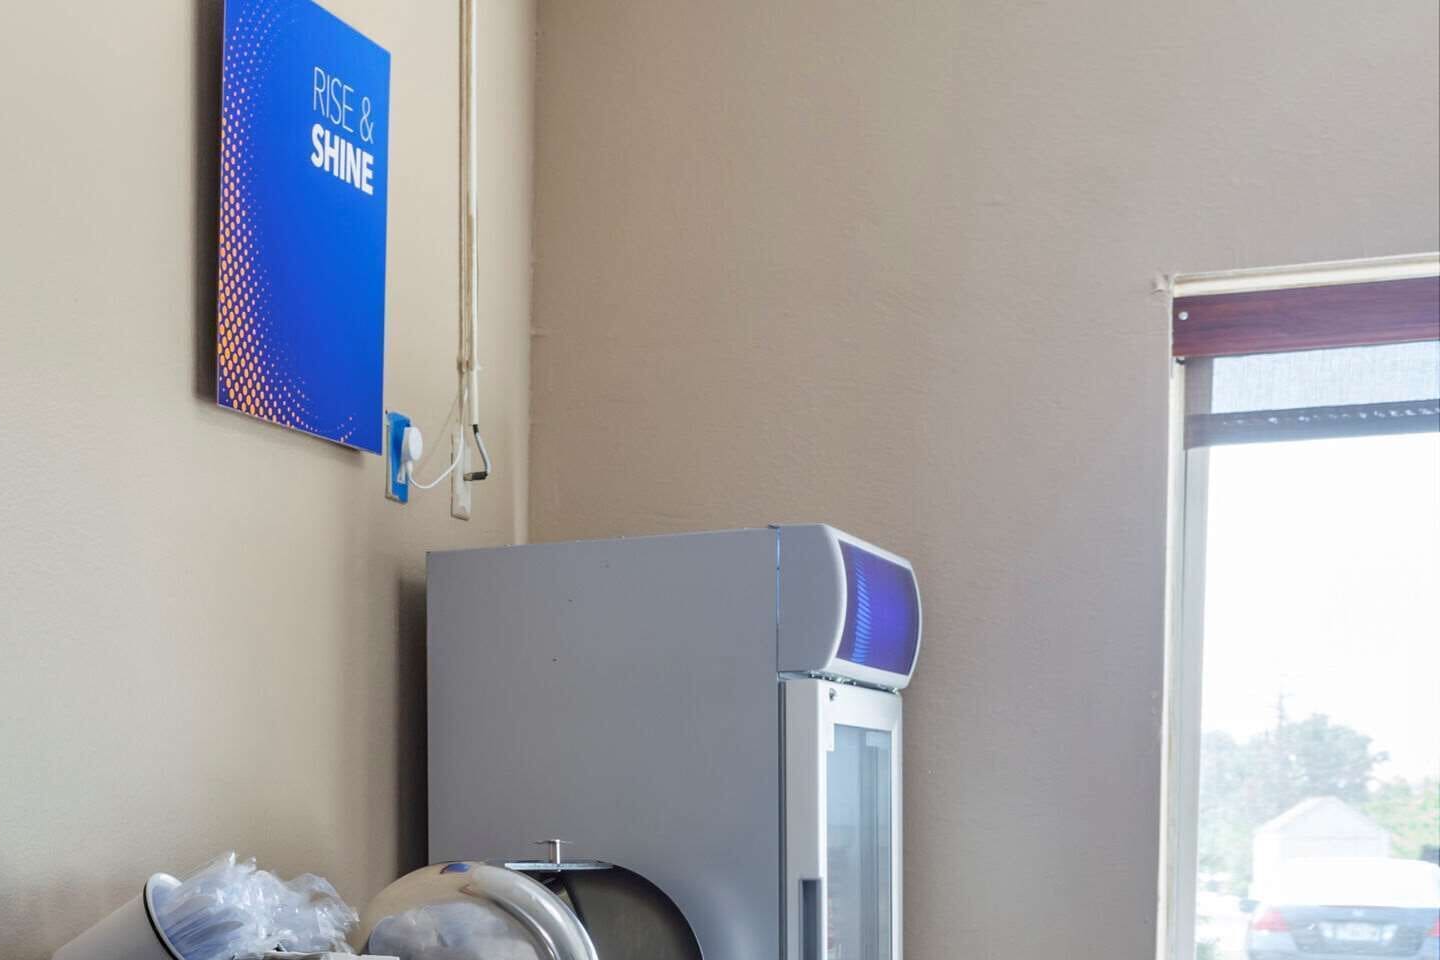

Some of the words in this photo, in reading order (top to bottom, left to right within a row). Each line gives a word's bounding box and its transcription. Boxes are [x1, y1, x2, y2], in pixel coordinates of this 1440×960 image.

[313, 66, 354, 133] RISE
[360, 96, 374, 144] &
[311, 123, 374, 196] SHINE
